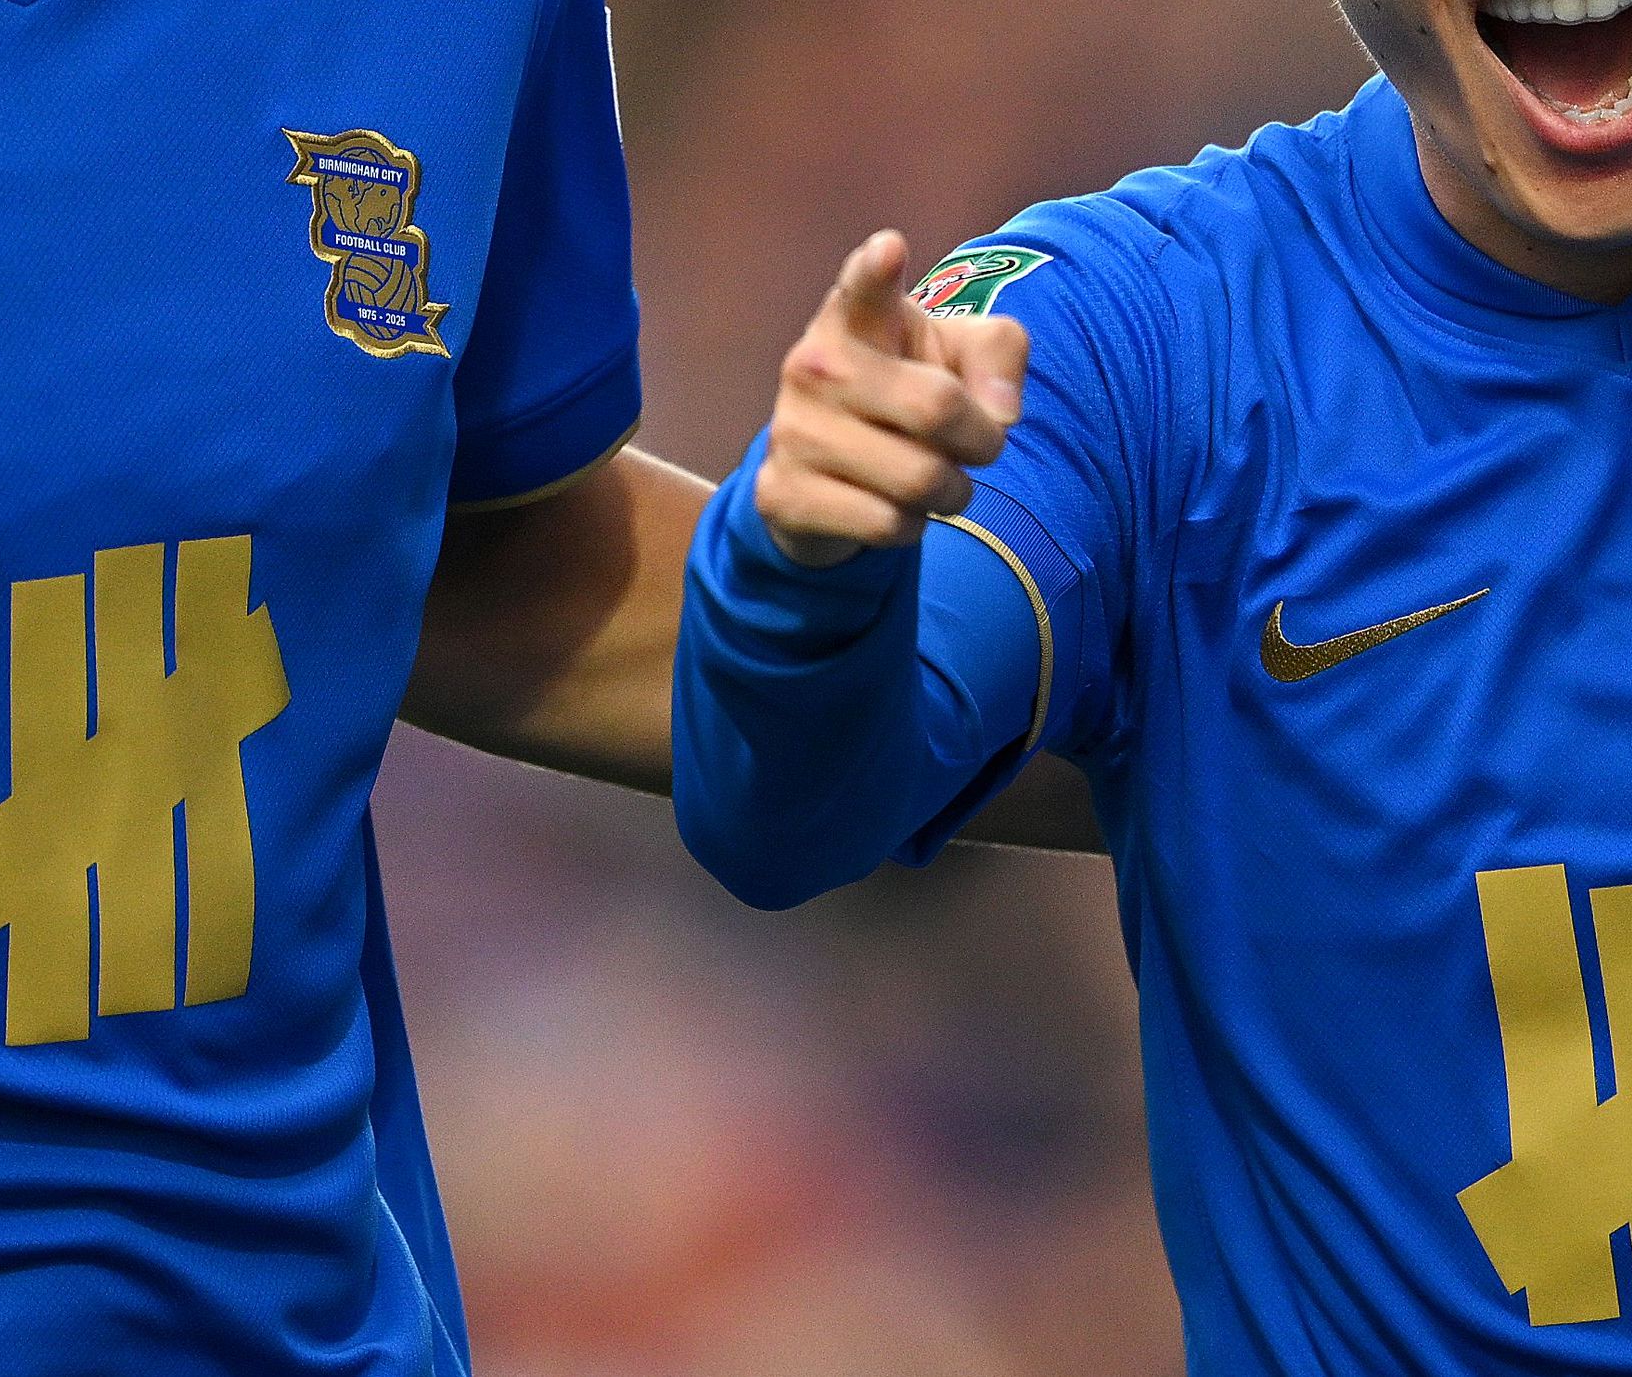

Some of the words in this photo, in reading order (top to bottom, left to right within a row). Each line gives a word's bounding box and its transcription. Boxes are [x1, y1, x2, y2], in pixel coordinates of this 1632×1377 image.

[318, 158, 380, 178] BIRMINGHAM
[381, 170, 403, 183] CITY
[335, 233, 382, 253] FOOTBALL
[382, 243, 406, 256] CLUB
[357, 307, 377, 320] 1875
[385, 313, 406, 326] 2025
